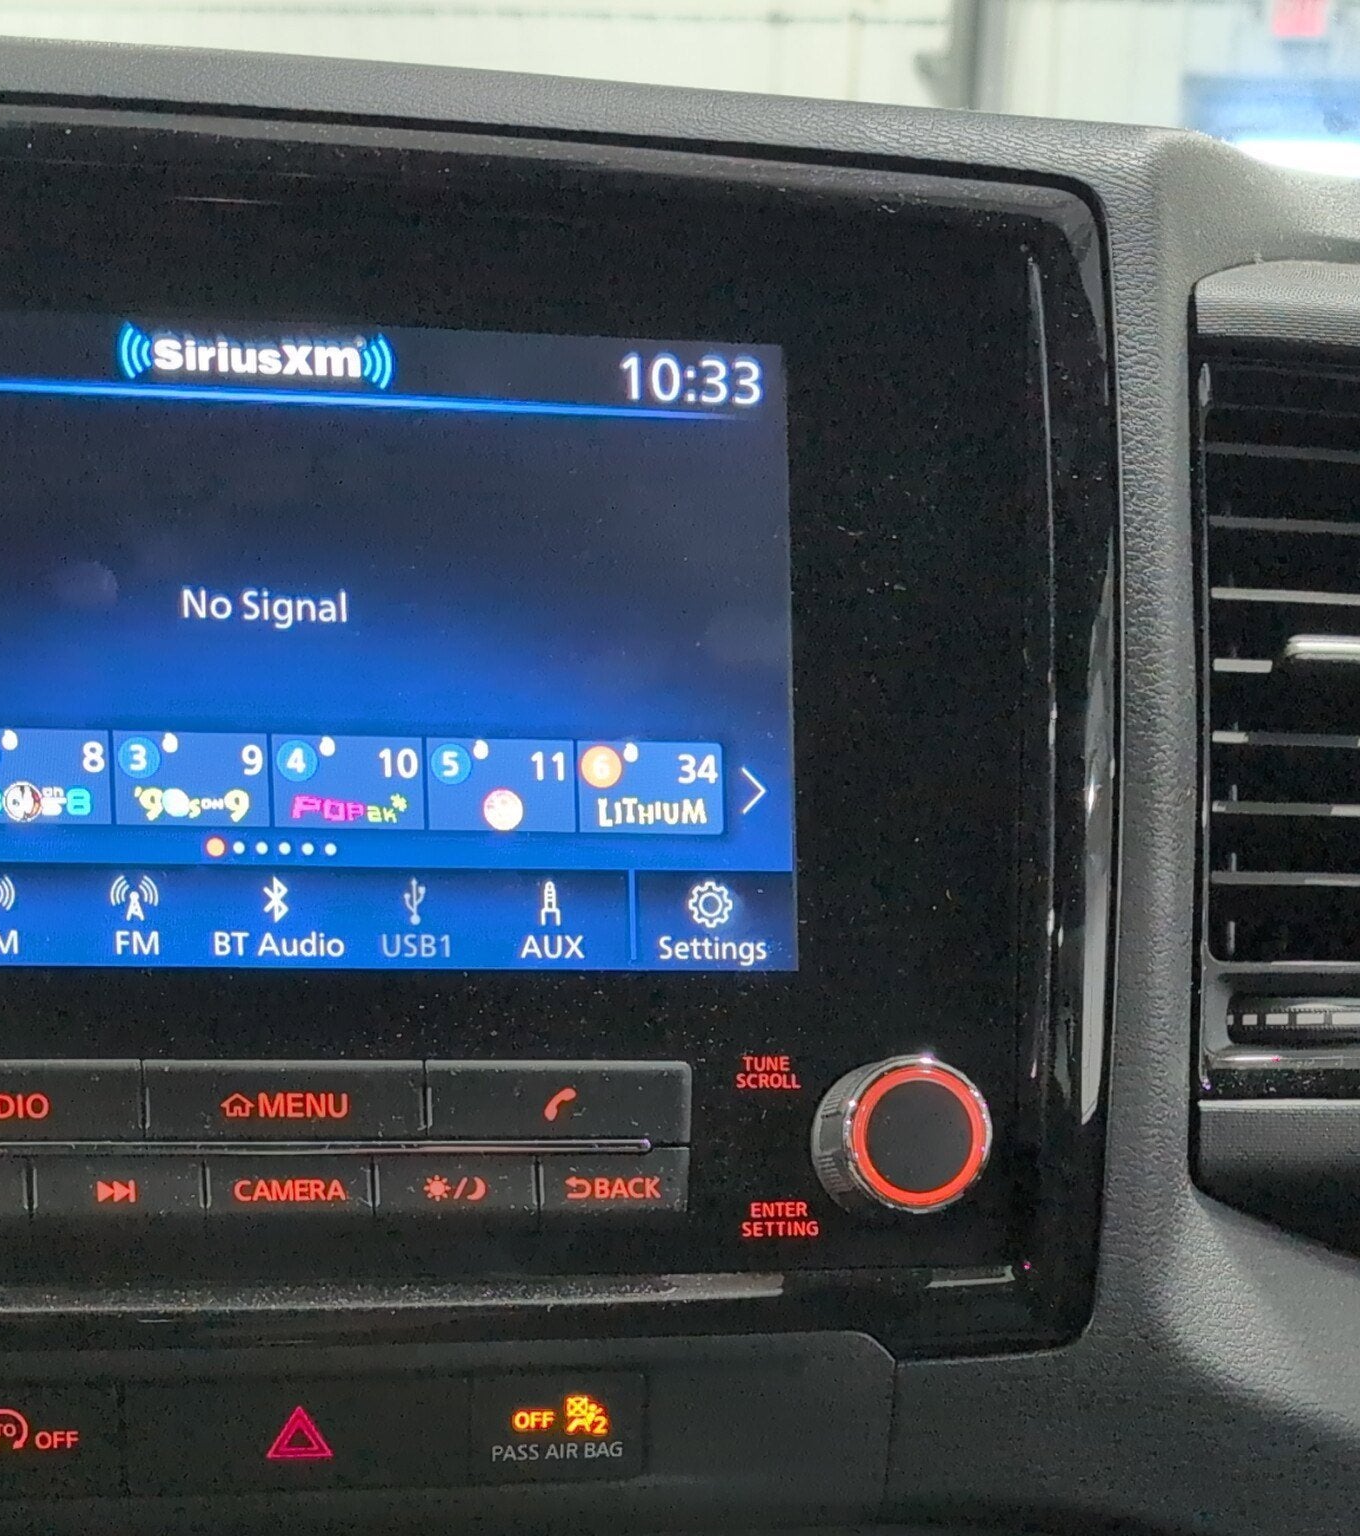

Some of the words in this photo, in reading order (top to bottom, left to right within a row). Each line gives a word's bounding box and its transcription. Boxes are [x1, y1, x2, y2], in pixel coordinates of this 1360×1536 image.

[619, 355, 763, 405] 10:33
[181, 589, 234, 622] No
[242, 592, 349, 630] Signal
[82, 743, 106, 773] 8
[130, 744, 148, 771] 3
[241, 745, 264, 776] 9
[286, 747, 304, 774] 4
[379, 747, 418, 780] 10
[442, 750, 459, 776] 5
[531, 750, 566, 782] 11
[677, 753, 719, 785] 34
[116, 931, 160, 956] FM
[214, 932, 249, 956] BT
[257, 931, 345, 958] Audio
[381, 935, 451, 959] USB1
[520, 936, 585, 959] AUX
[658, 935, 767, 967] Settings
[743, 1056, 790, 1073] TUNE
[736, 1072, 801, 1089] SCROLL
[257, 1092, 349, 1119] MENU
[234, 1178, 346, 1202] CAMERA
[594, 1176, 661, 1200] BACK
[750, 1201, 808, 1219] ENTER
[741, 1220, 819, 1238] SETTING
[513, 1410, 555, 1430] OFF
[35, 1431, 79, 1450] OFF
[491, 1443, 540, 1462] PASS
[544, 1442, 579, 1460] AIR
[583, 1441, 623, 1459] BAG
